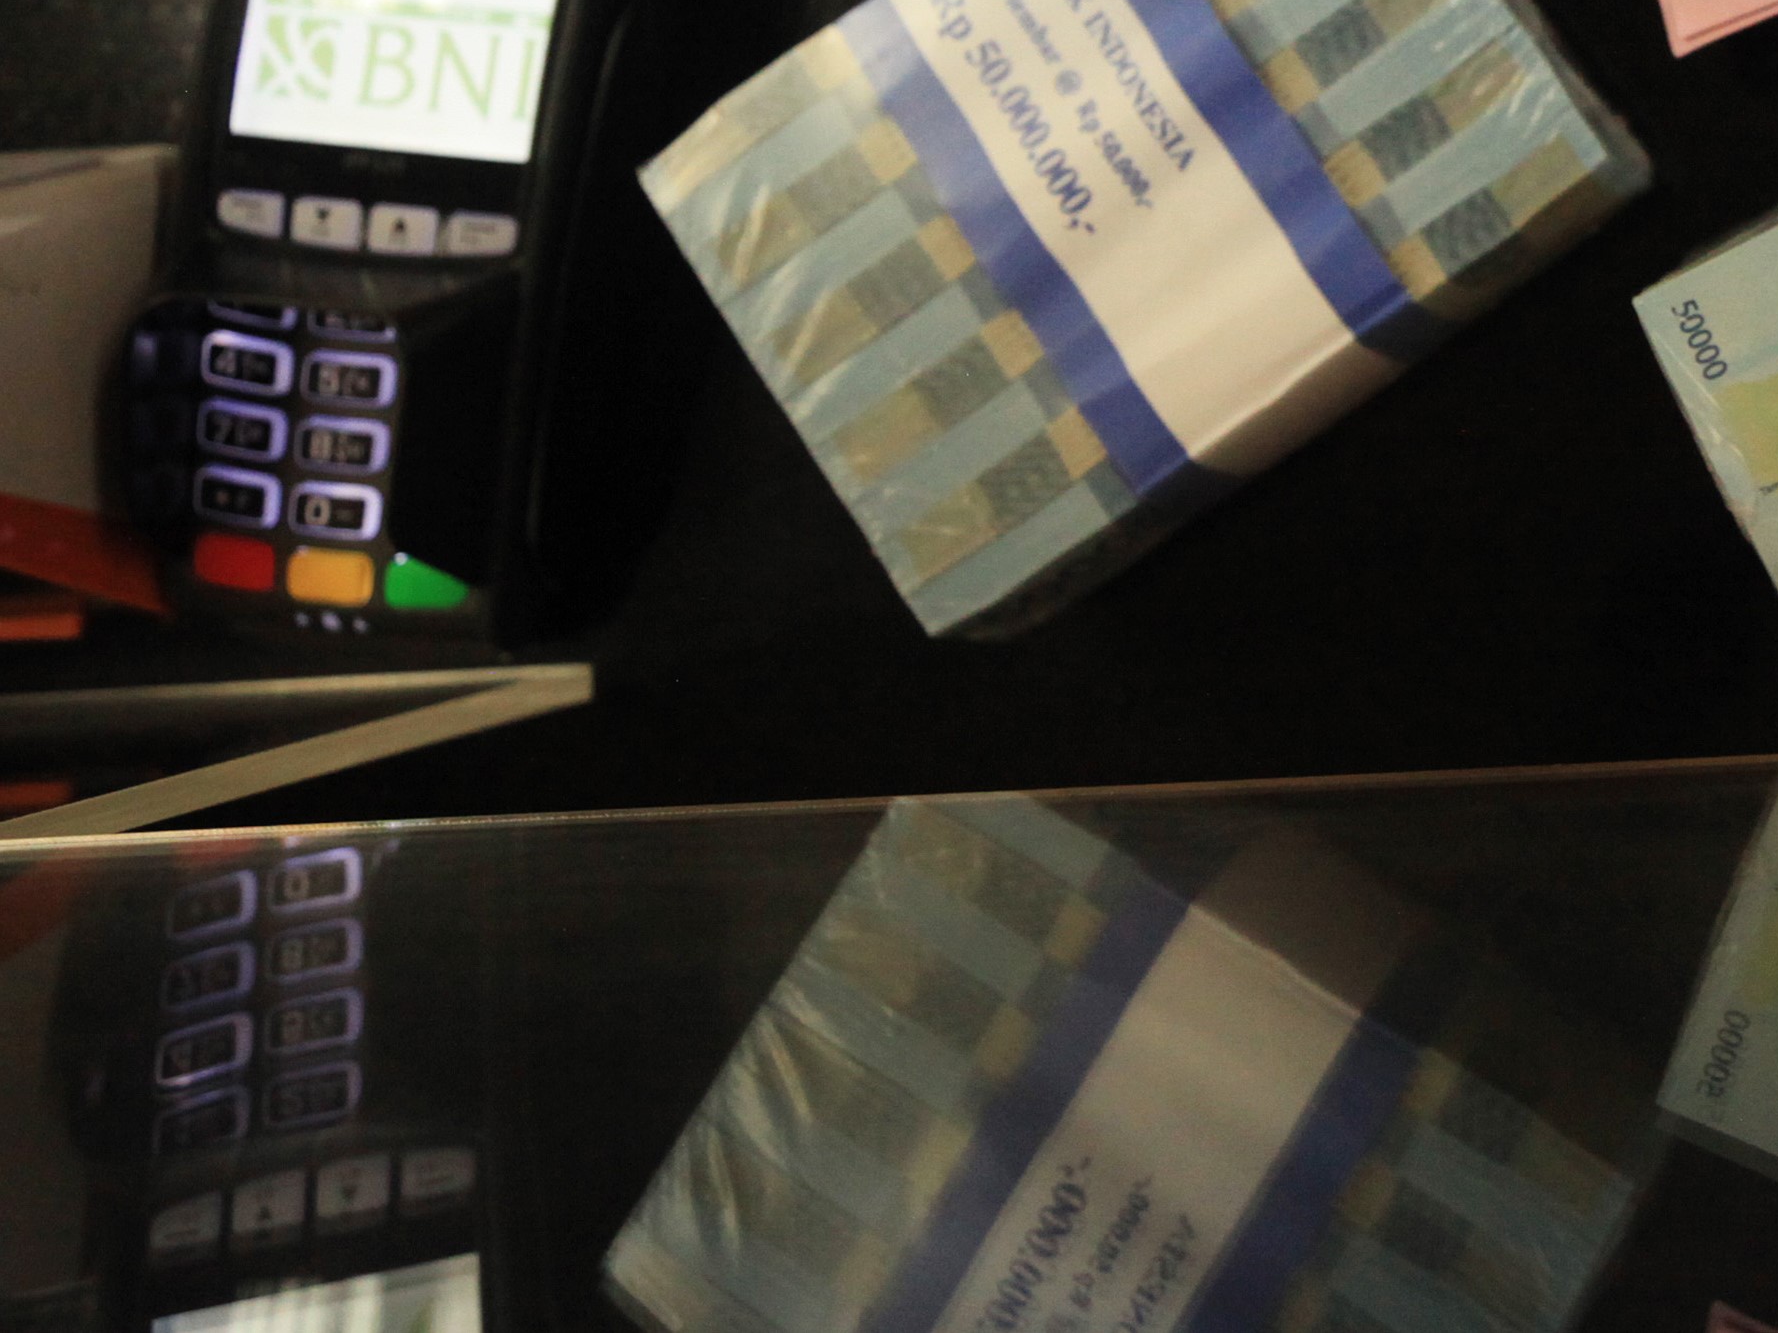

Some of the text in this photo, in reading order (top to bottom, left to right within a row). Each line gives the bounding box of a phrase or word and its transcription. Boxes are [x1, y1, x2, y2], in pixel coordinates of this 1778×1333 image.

[358, 23, 538, 121] BNI
[1084, 11, 1195, 172] INDONESIA
[1671, 298, 1729, 381] 50000
